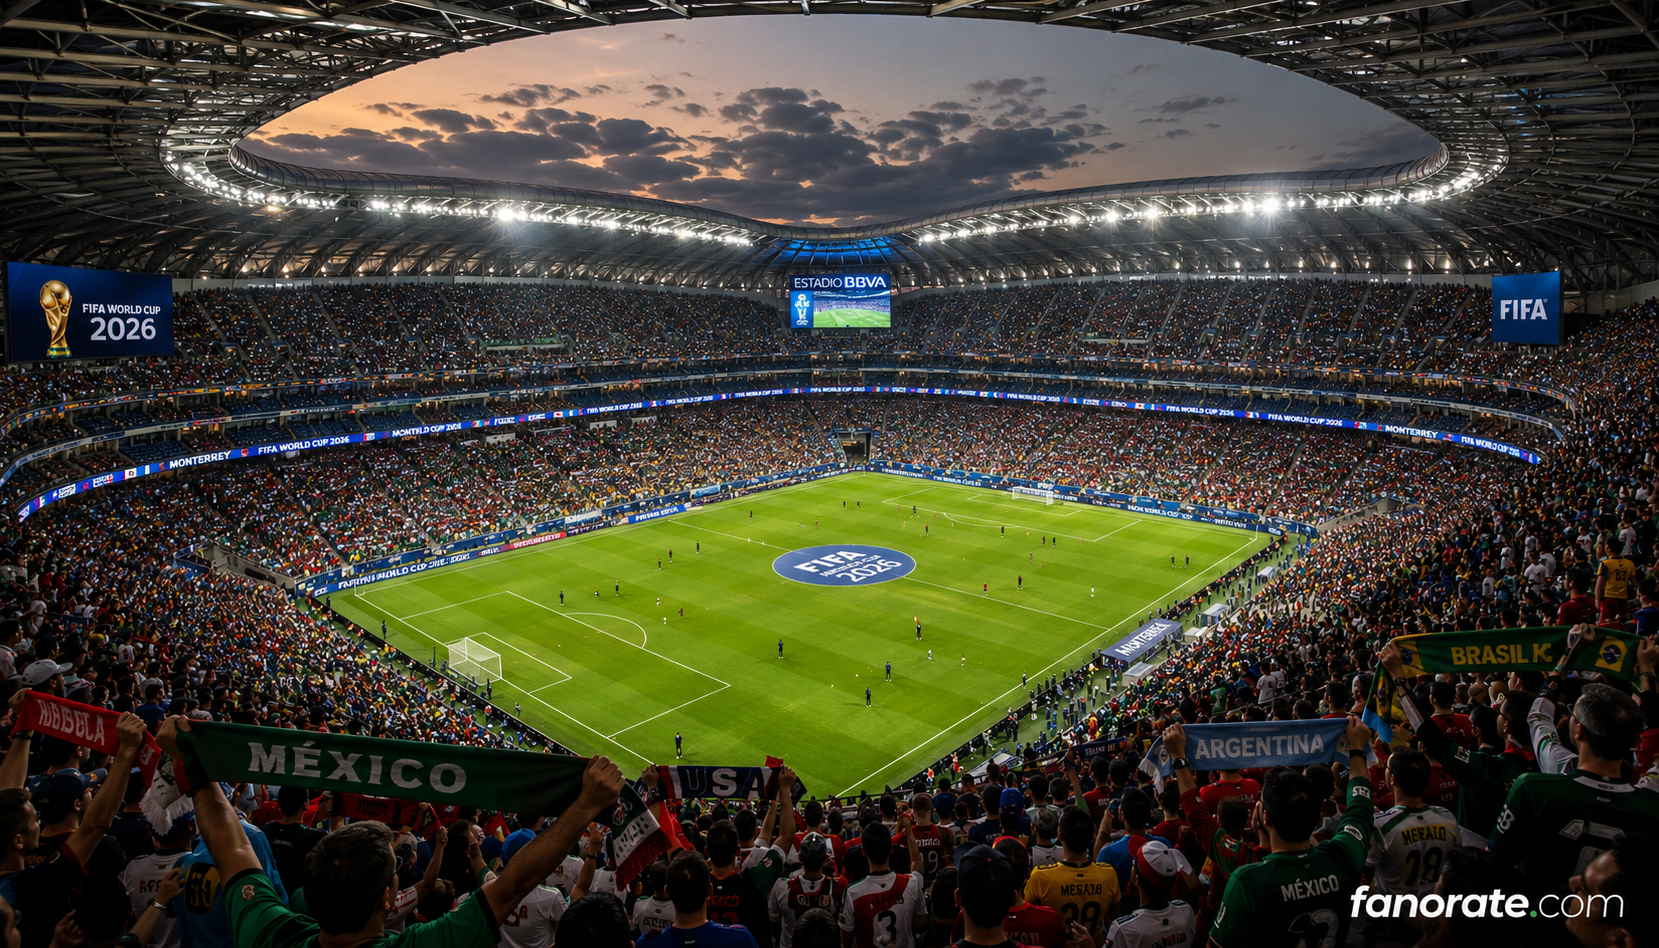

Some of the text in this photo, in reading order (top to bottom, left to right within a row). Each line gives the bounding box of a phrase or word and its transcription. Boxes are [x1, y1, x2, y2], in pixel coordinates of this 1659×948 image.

[794, 276, 887, 289] ESTADIO BBVA
[82, 303, 161, 315] FIFA WORLD CUP
[90, 317, 157, 341] 2026
[1310, 417, 1325, 425] CUP
[169, 450, 232, 470] MONTERREY
[258, 445, 279, 455] FIFA
[279, 440, 311, 452] WORLD
[312, 438, 329, 448] CUP
[793, 551, 867, 573] FIFA
[836, 559, 903, 583] 2026
[1450, 644, 1530, 666] BRASIL
[1195, 733, 1325, 760] ARGENTINA
[247, 740, 467, 794] MÉXICO
[682, 767, 767, 799] USA
[1280, 874, 1340, 902] MÉXICO
